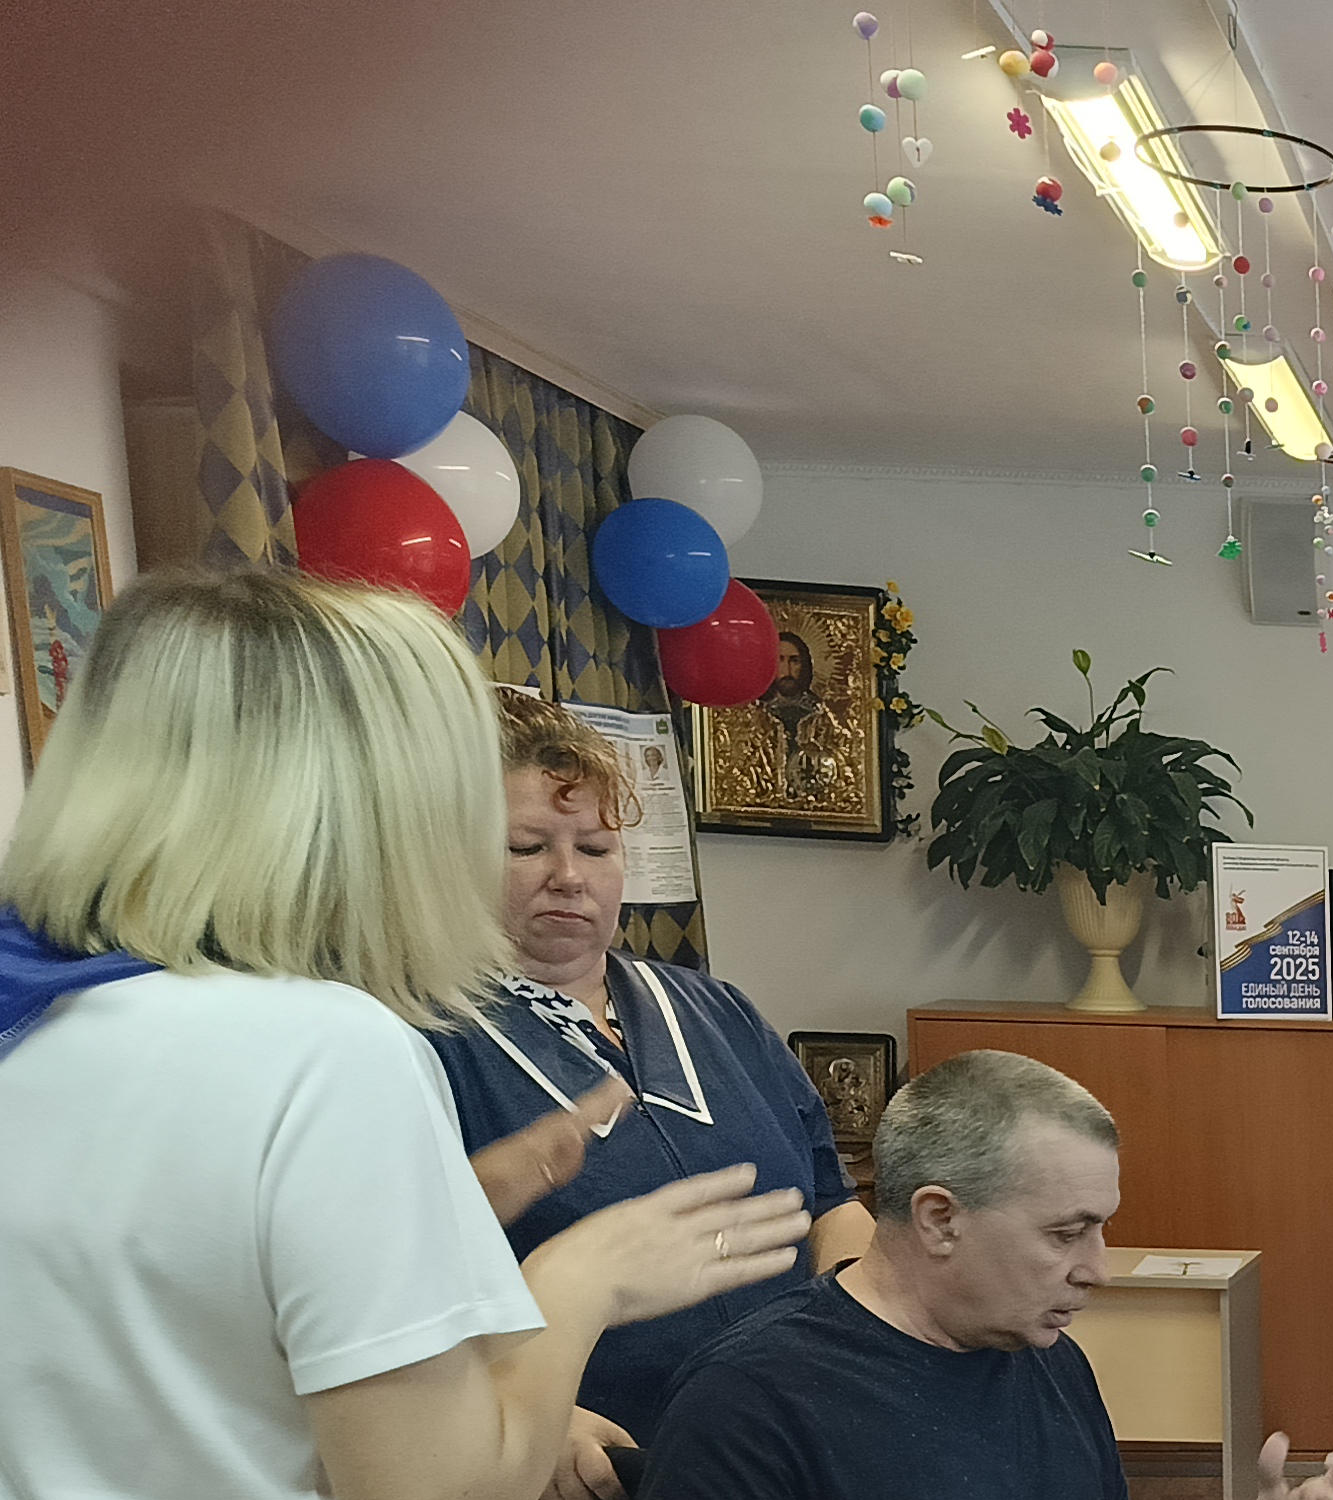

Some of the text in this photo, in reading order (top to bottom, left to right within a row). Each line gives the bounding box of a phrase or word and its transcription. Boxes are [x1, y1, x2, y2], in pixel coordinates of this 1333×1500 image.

[1287, 930, 1318, 945] 12-14
[1269, 943, 1320, 958] сентября
[1269, 957, 1320, 981] 2025
[1241, 981, 1321, 997] ЕДИНЫЙ ДЕНЬ
